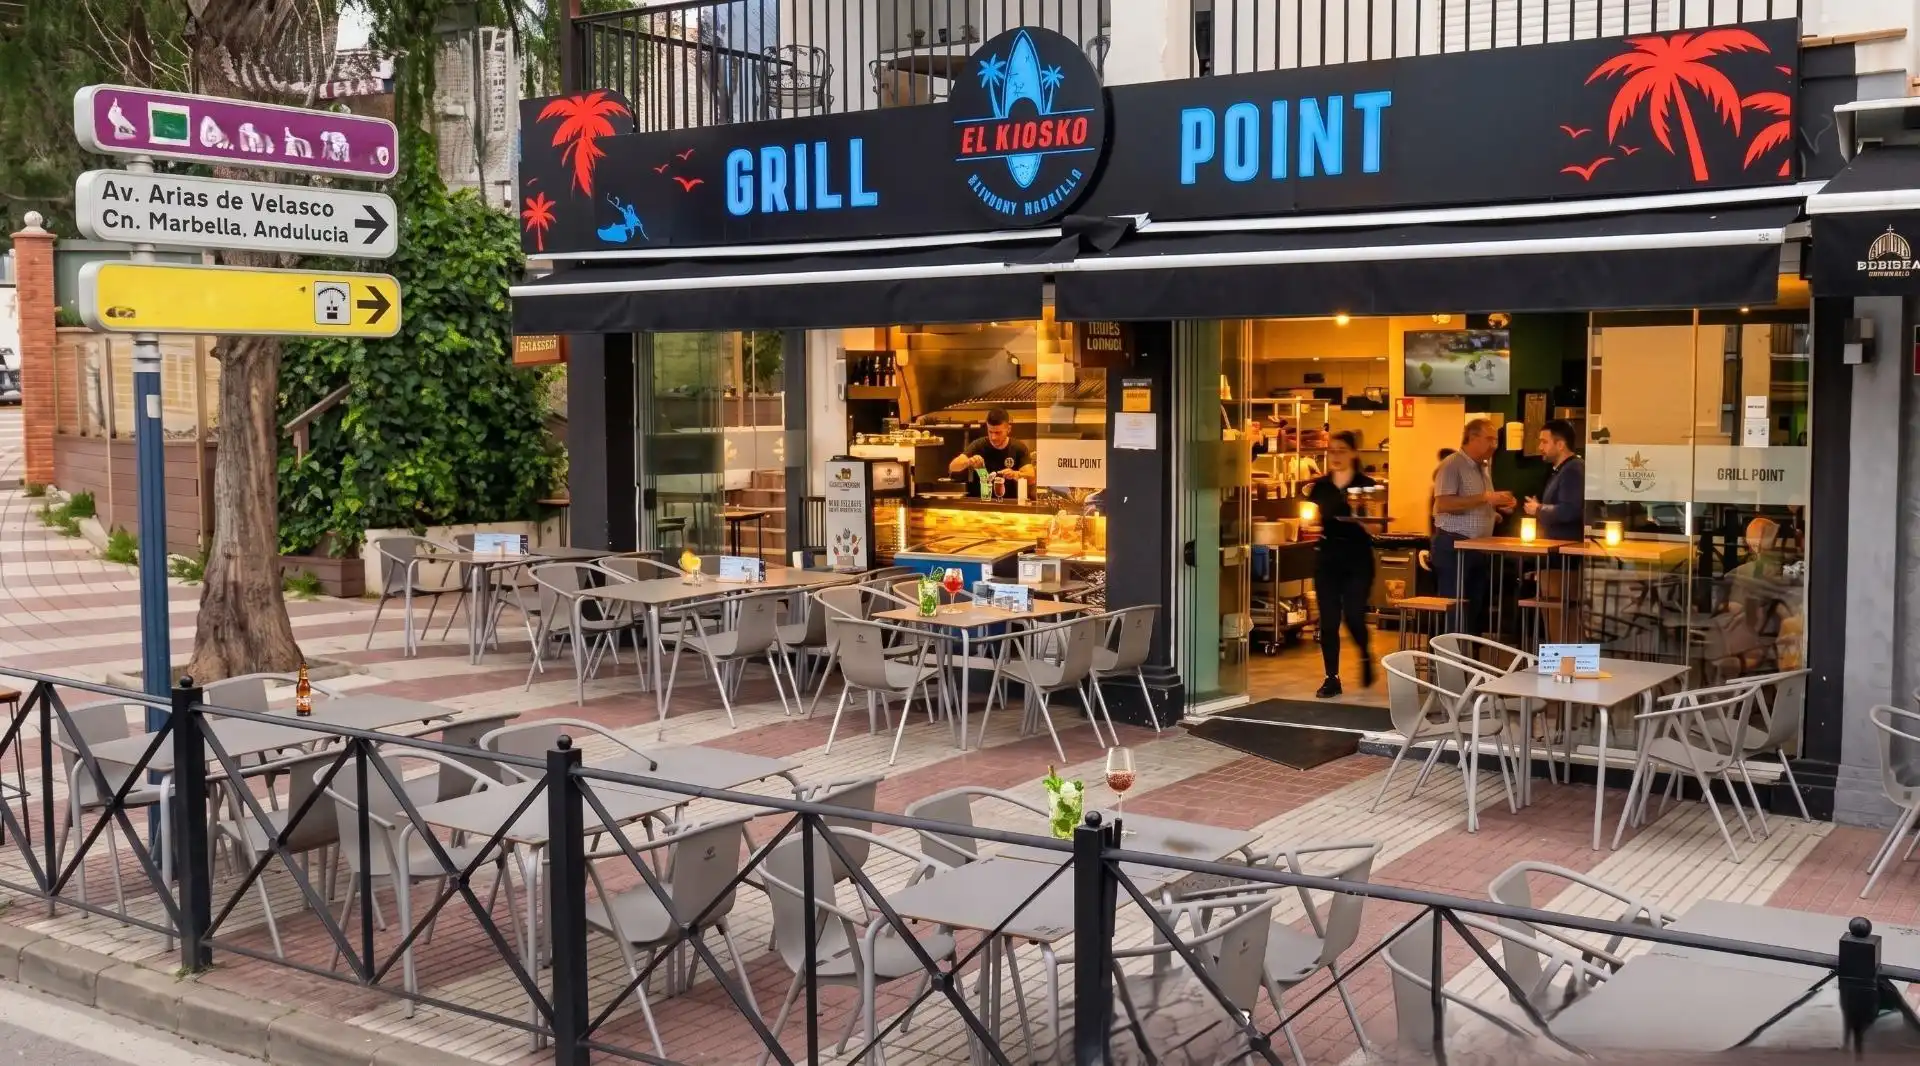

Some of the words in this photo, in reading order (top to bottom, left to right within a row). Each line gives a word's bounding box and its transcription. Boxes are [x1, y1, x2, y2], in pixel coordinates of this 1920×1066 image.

[726, 138, 879, 217] GRILL
[1179, 90, 1393, 186] POINT
[961, 127, 988, 154] EL
[995, 116, 1088, 151] KIOSKO
[102, 180, 140, 203] Av.
[148, 184, 209, 208] Arias
[216, 190, 244, 210] de
[251, 192, 335, 218] Velasco
[102, 208, 141, 230] Cn.
[253, 220, 349, 244] Andulucia
[1057, 457, 1079, 469] GRILL
[1080, 458, 1103, 469] POINT
[1717, 467, 1749, 481] GRILL
[1751, 468, 1785, 482] POINT
